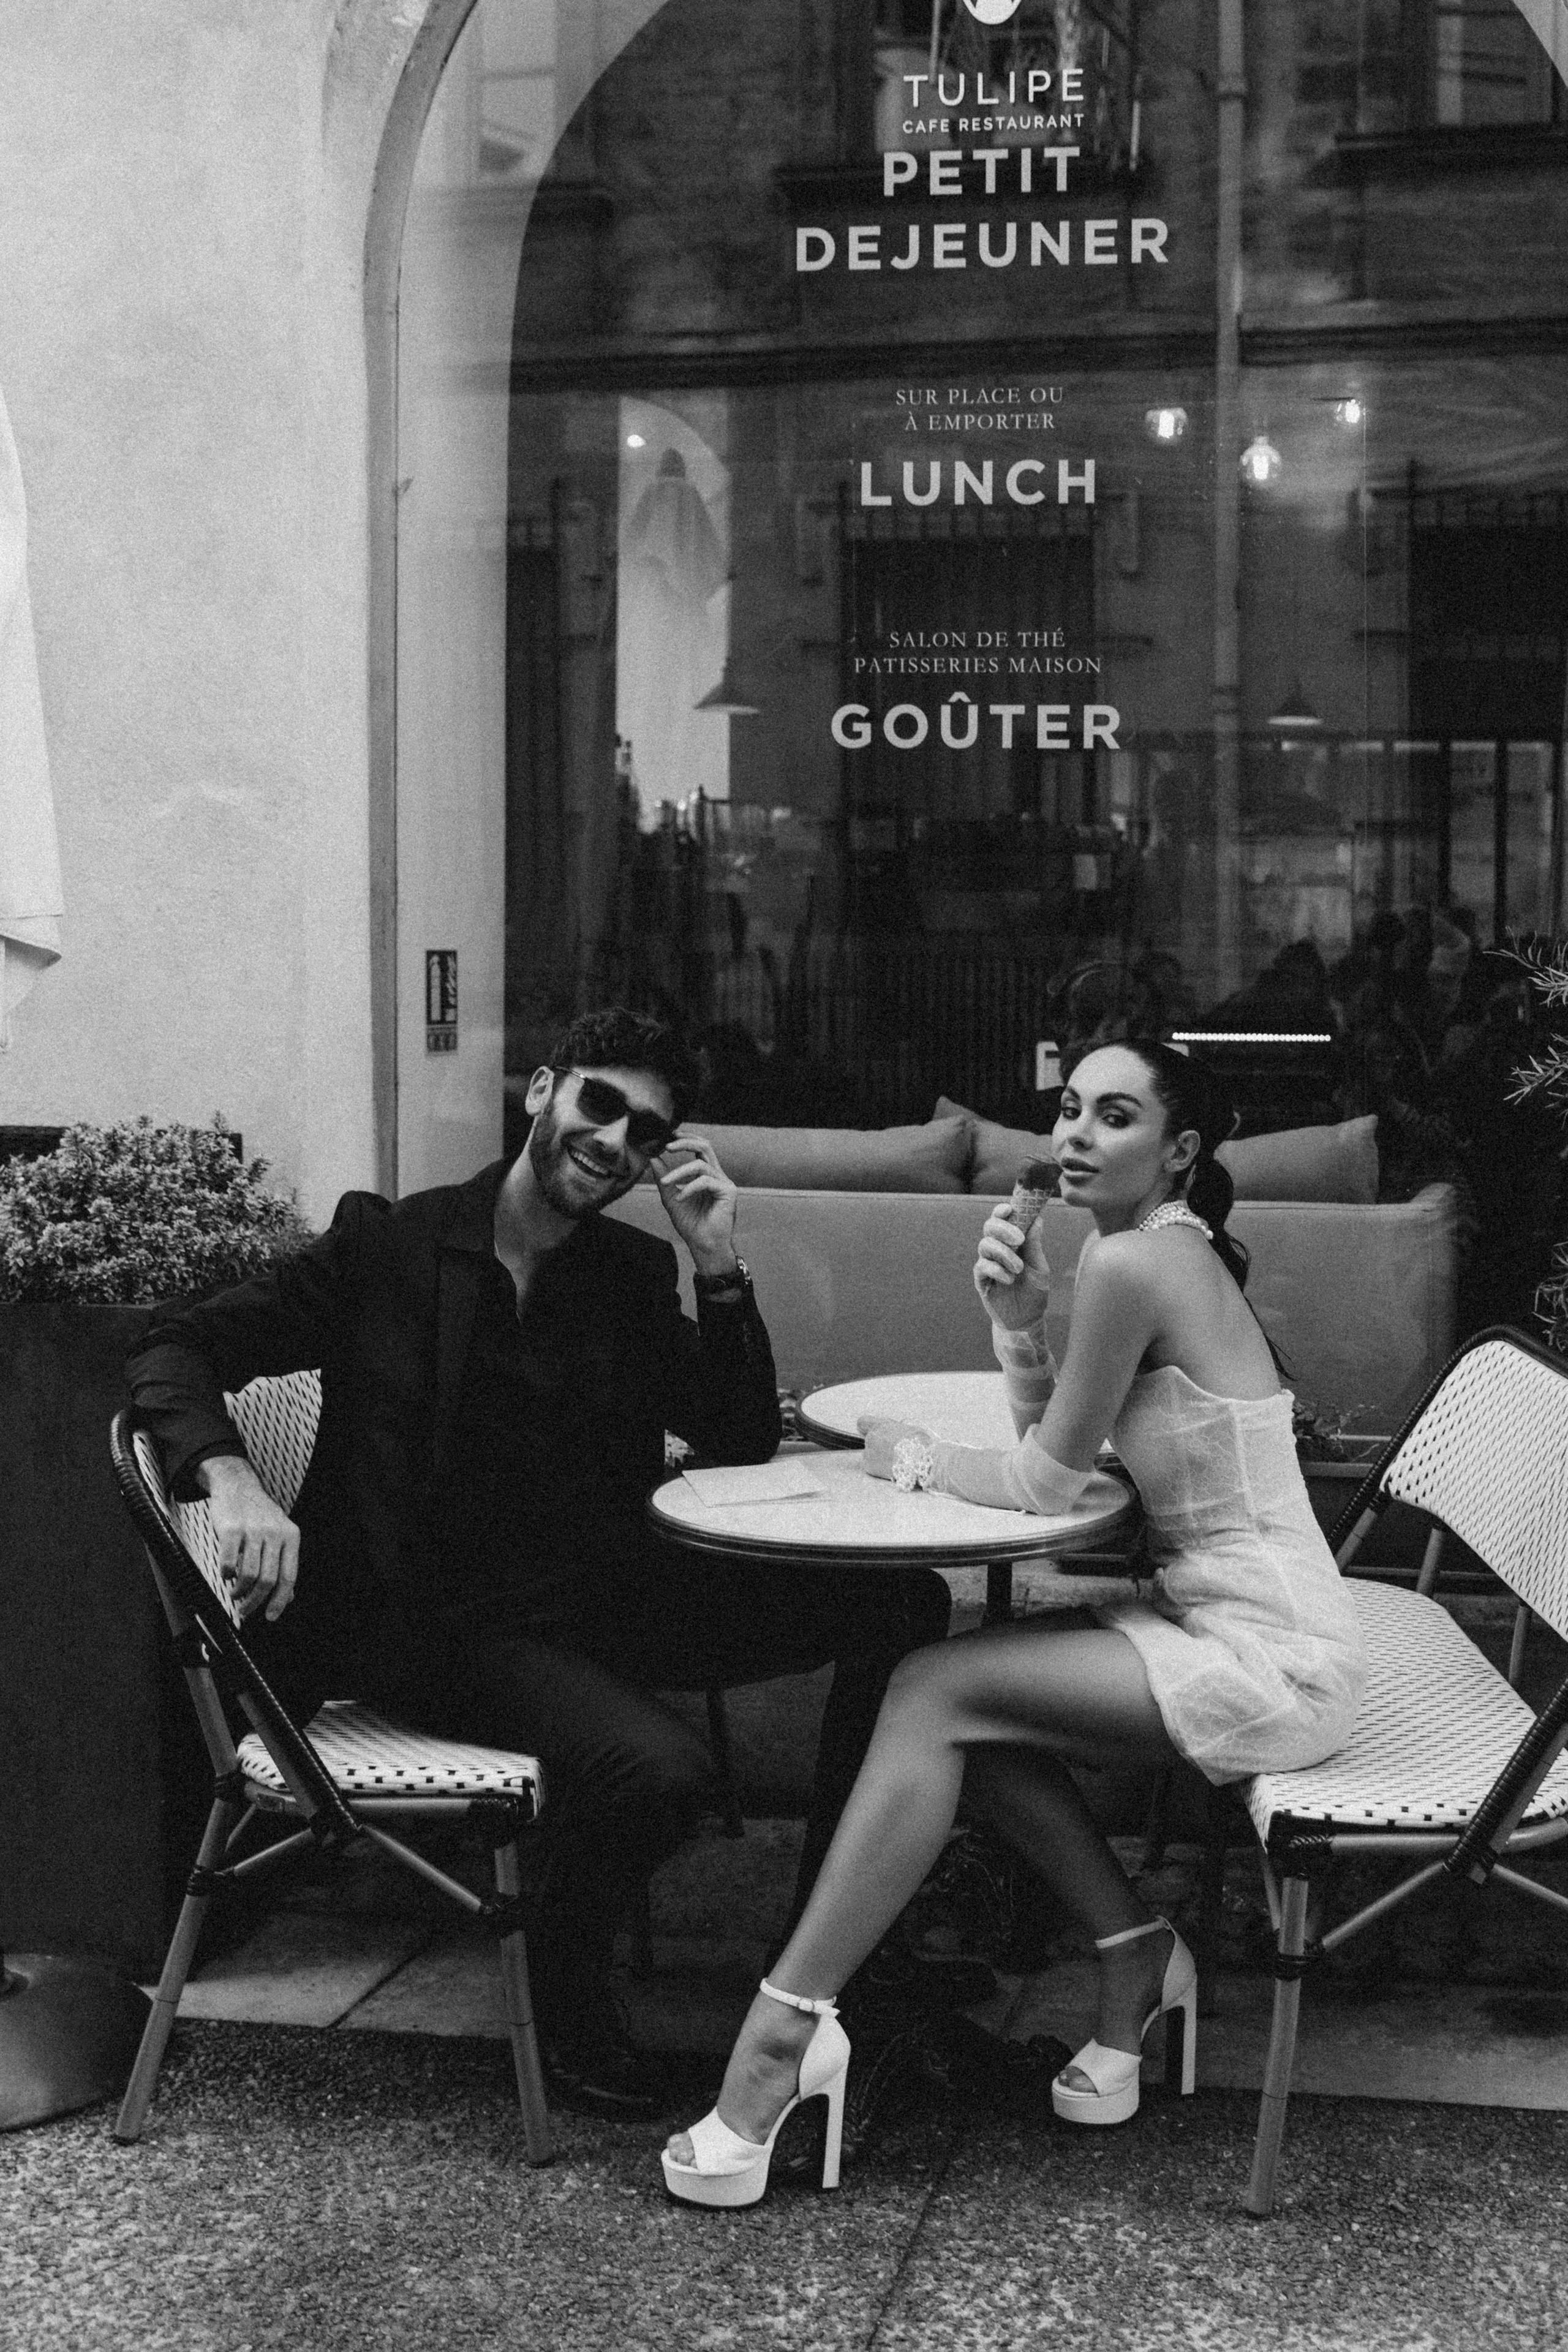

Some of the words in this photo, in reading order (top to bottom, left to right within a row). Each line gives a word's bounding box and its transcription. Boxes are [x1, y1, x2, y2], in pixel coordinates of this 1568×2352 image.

[903, 68, 1084, 108] TULIPE
[902, 118, 950, 134] CAFE
[959, 113, 1084, 131] RESTAURANT
[884, 146, 1080, 196] PETIT
[796, 218, 1168, 271] DEJEUNER
[896, 389, 938, 405] SUR
[949, 388, 1020, 405] PLACE
[1030, 386, 1063, 404] OU
[905, 411, 918, 431] À
[929, 413, 1054, 430] EMPORTER
[861, 459, 1095, 505] LUNCH
[890, 632, 966, 648] SALON
[976, 631, 1008, 647] DE
[1017, 627, 1065, 647] THÉ
[855, 657, 999, 673] PATISSERIES
[1009, 657, 1101, 673] MAISON
[831, 692, 1120, 749] GOÛTER
